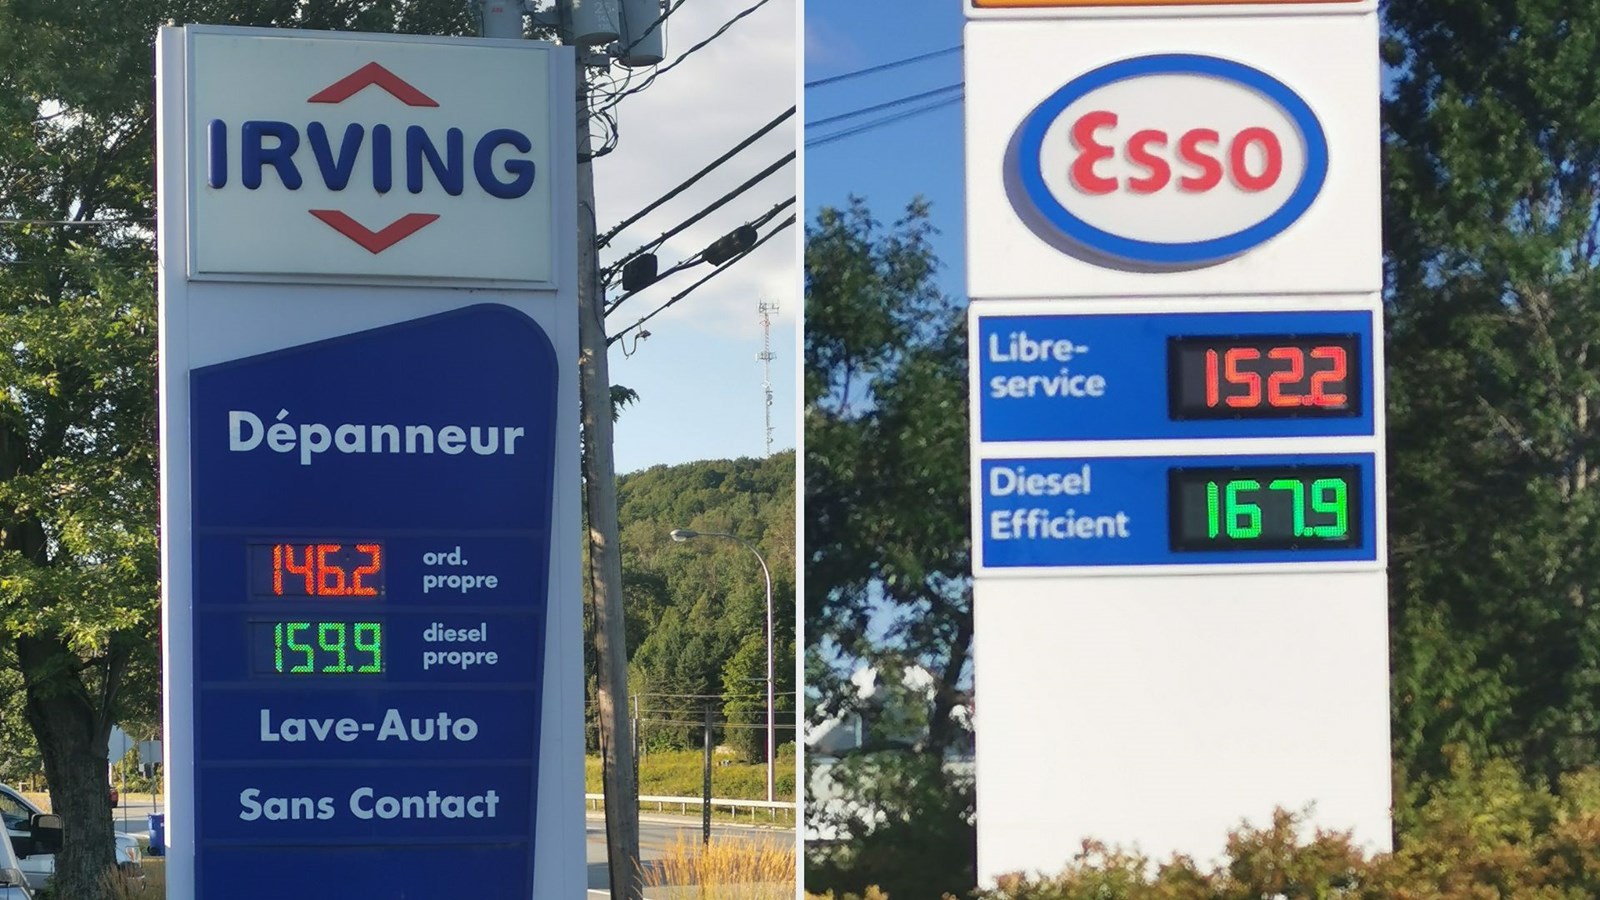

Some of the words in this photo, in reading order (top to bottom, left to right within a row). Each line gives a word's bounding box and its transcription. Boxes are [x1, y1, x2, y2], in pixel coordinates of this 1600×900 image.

[207, 118, 536, 199] IRVING
[989, 331, 1089, 362] Libre-
[990, 369, 1106, 398] service
[1205, 346, 1348, 408] 152.2
[228, 408, 526, 466] Dépanneur
[989, 465, 1092, 497] Diesel
[990, 508, 1132, 541] Efficient
[1206, 478, 1348, 539] 167.9
[273, 543, 382, 596] 146.2
[422, 545, 469, 566] ord.
[422, 574, 499, 595] propre
[274, 622, 382, 674] 159.9
[422, 621, 488, 643] diesel
[422, 650, 499, 671] propre
[260, 708, 479, 742] Lave-Auto
[239, 788, 335, 821] Sans
[349, 787, 499, 820] Contact
